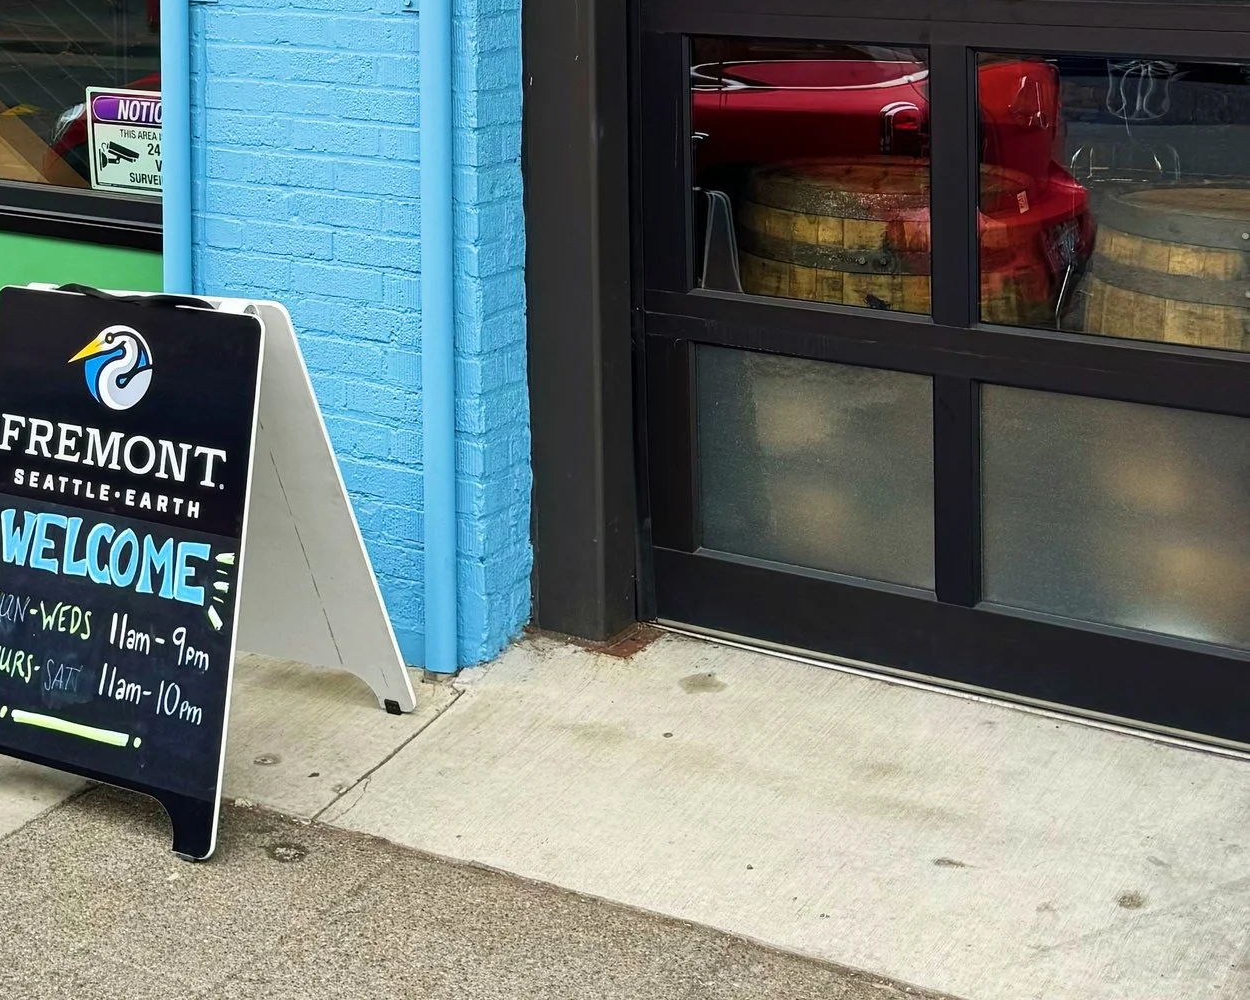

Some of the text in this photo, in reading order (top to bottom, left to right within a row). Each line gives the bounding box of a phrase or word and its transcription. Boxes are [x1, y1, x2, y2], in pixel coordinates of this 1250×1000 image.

[120, 128, 137, 140] THIS
[137, 131, 158, 141] AREA
[147, 143, 161, 157] 24
[0, 508, 212, 607] WELCOME
